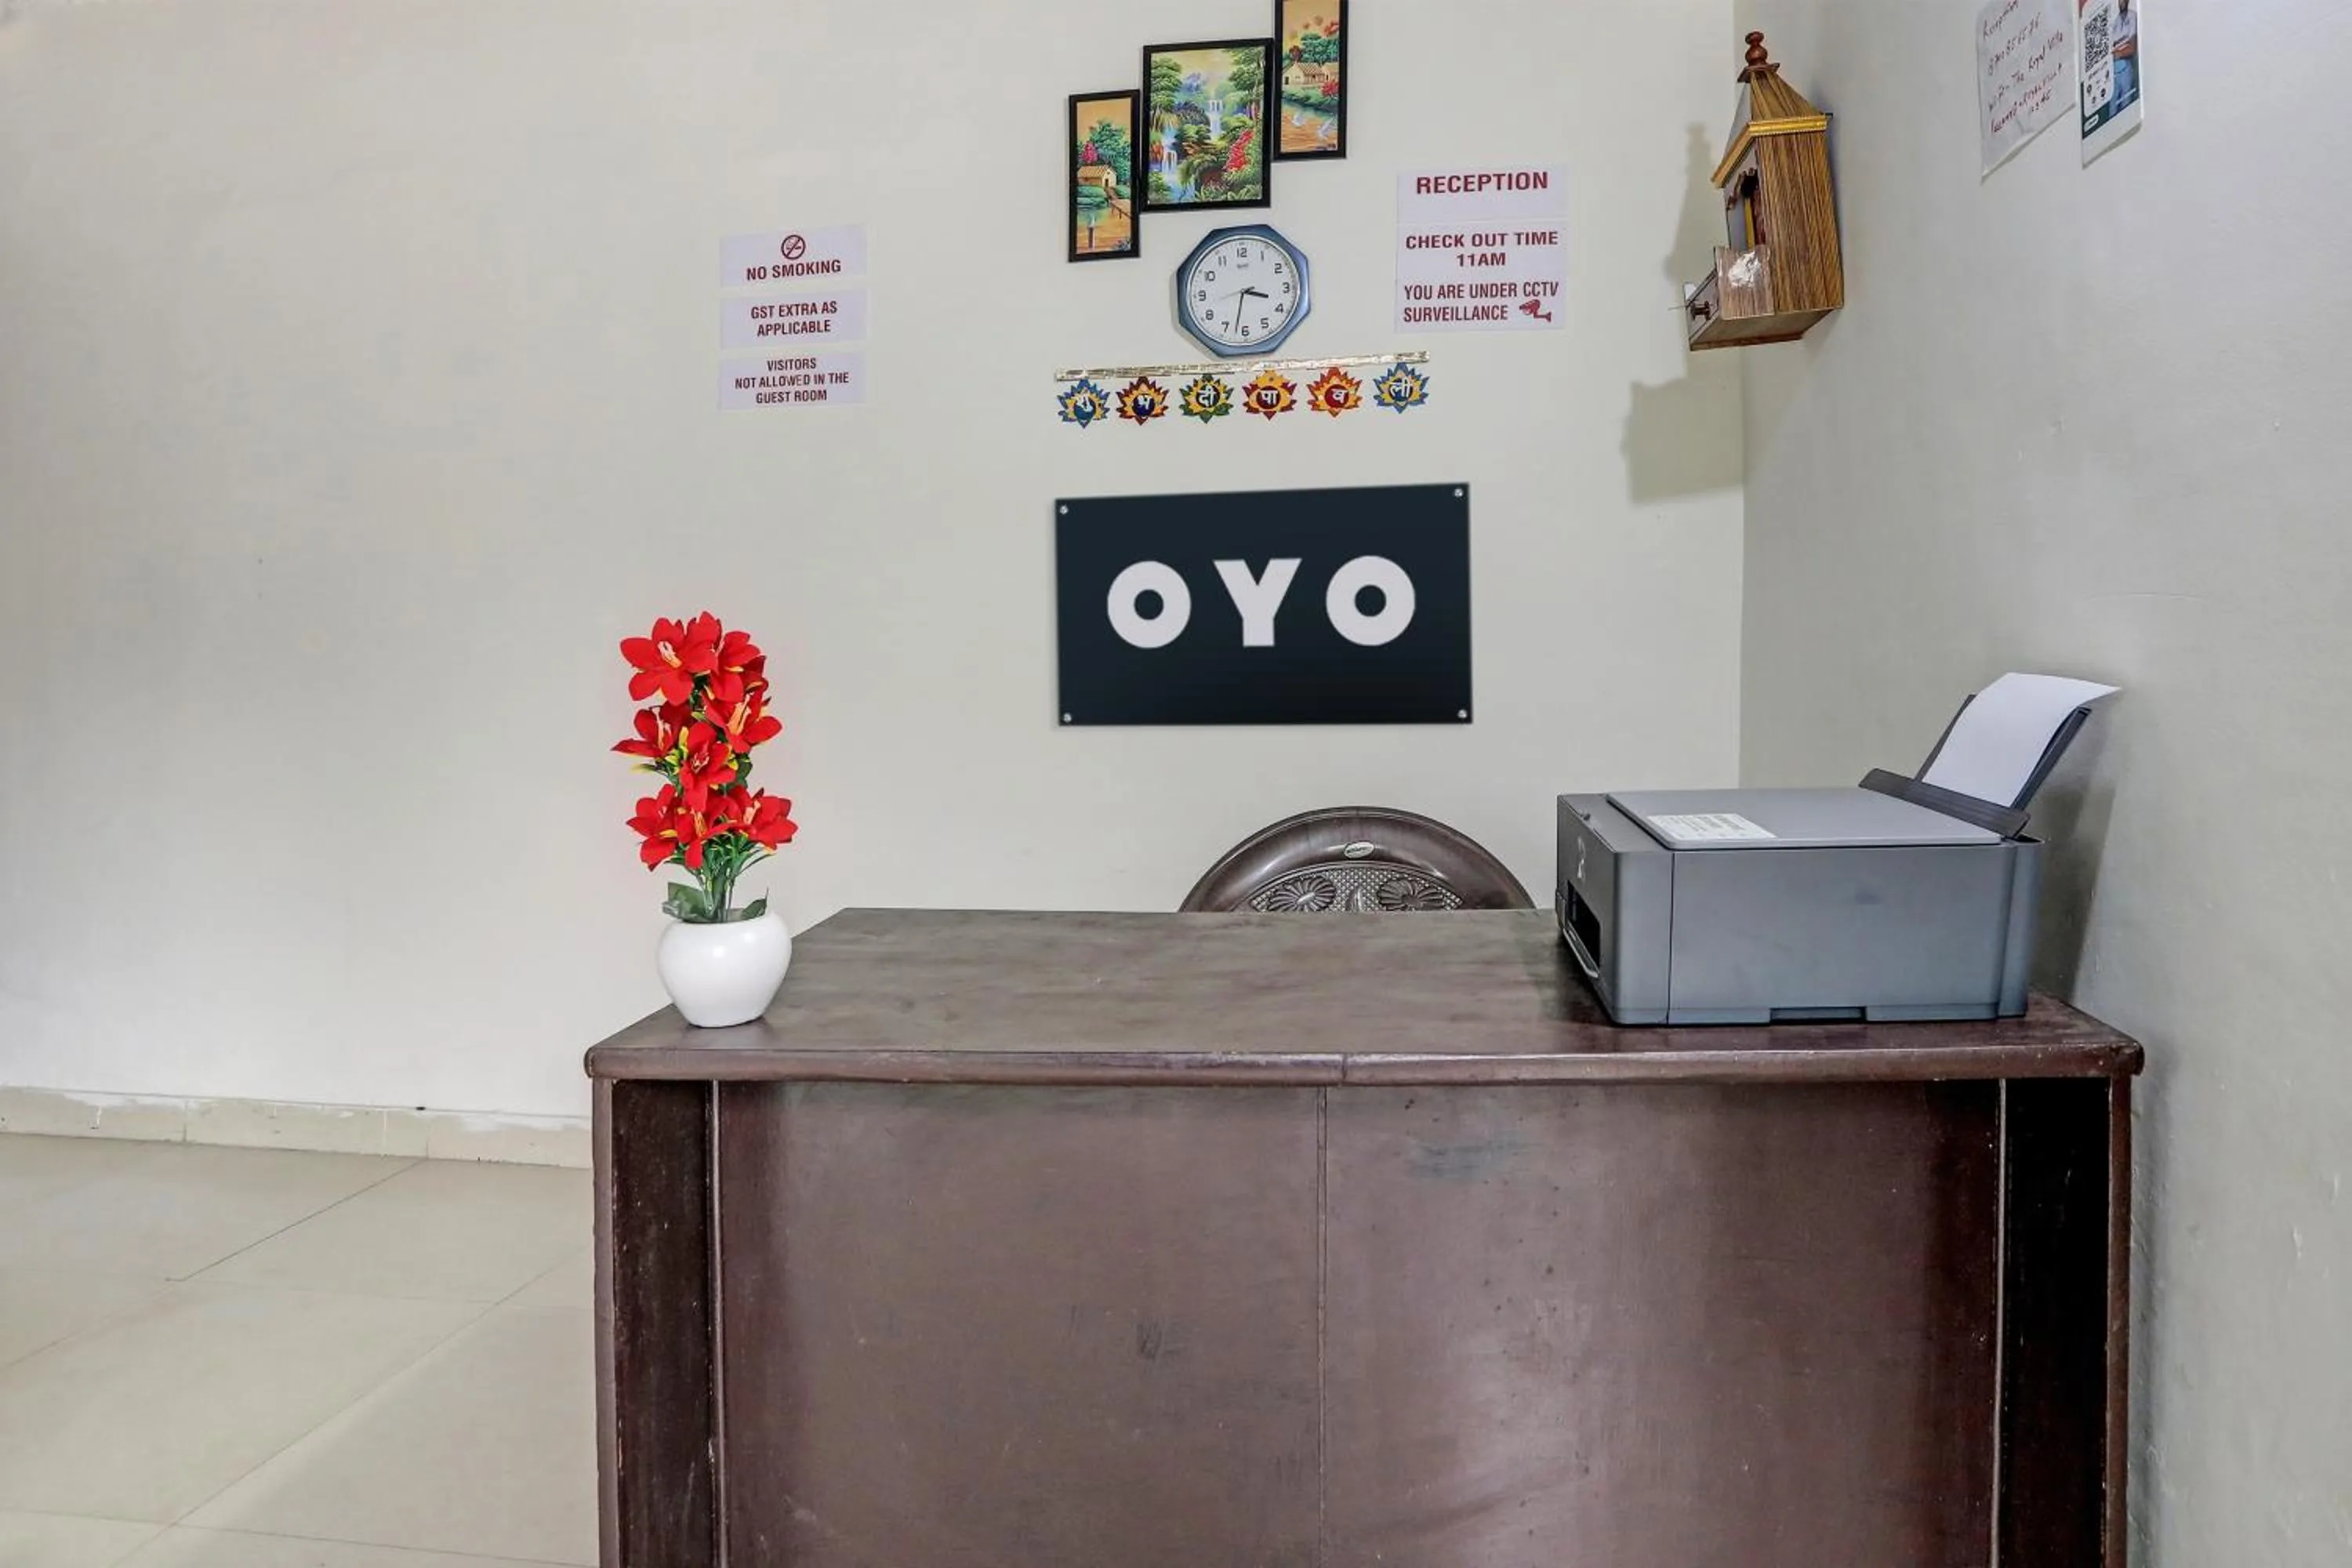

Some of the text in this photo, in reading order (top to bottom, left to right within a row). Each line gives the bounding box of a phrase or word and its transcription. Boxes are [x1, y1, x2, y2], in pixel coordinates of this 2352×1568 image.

[1416, 172, 1548, 194] RECEPTION
[1406, 231, 1559, 249] CHECK OUT TIME
[1236, 247, 1247, 258] 12
[1457, 252, 1506, 267] 11AM
[1218, 256, 1226, 267] 11
[1275, 263, 1283, 274] 2
[746, 260, 841, 281] NO SMOKING
[1205, 270, 1215, 281] 10
[1283, 282, 1290, 293] 3
[1404, 281, 1559, 300] YOU ARE UNDER CCTV
[1198, 290, 1207, 301] 9
[751, 301, 837, 318] GST EXTRA AS
[1206, 310, 1214, 321] 8
[1275, 303, 1283, 314] 4
[1403, 305, 1508, 323] SURVEILLANCE
[757, 320, 831, 337] APPLICABLE
[1221, 321, 1229, 333] 7
[1261, 318, 1269, 328] 5
[1242, 326, 1250, 336] 6
[767, 358, 816, 372] VISITORS
[735, 372, 849, 389] NOT ALLOWED IN THE
[756, 390, 827, 404] GUEST ROOM
[1107, 555, 1416, 648] OYO
